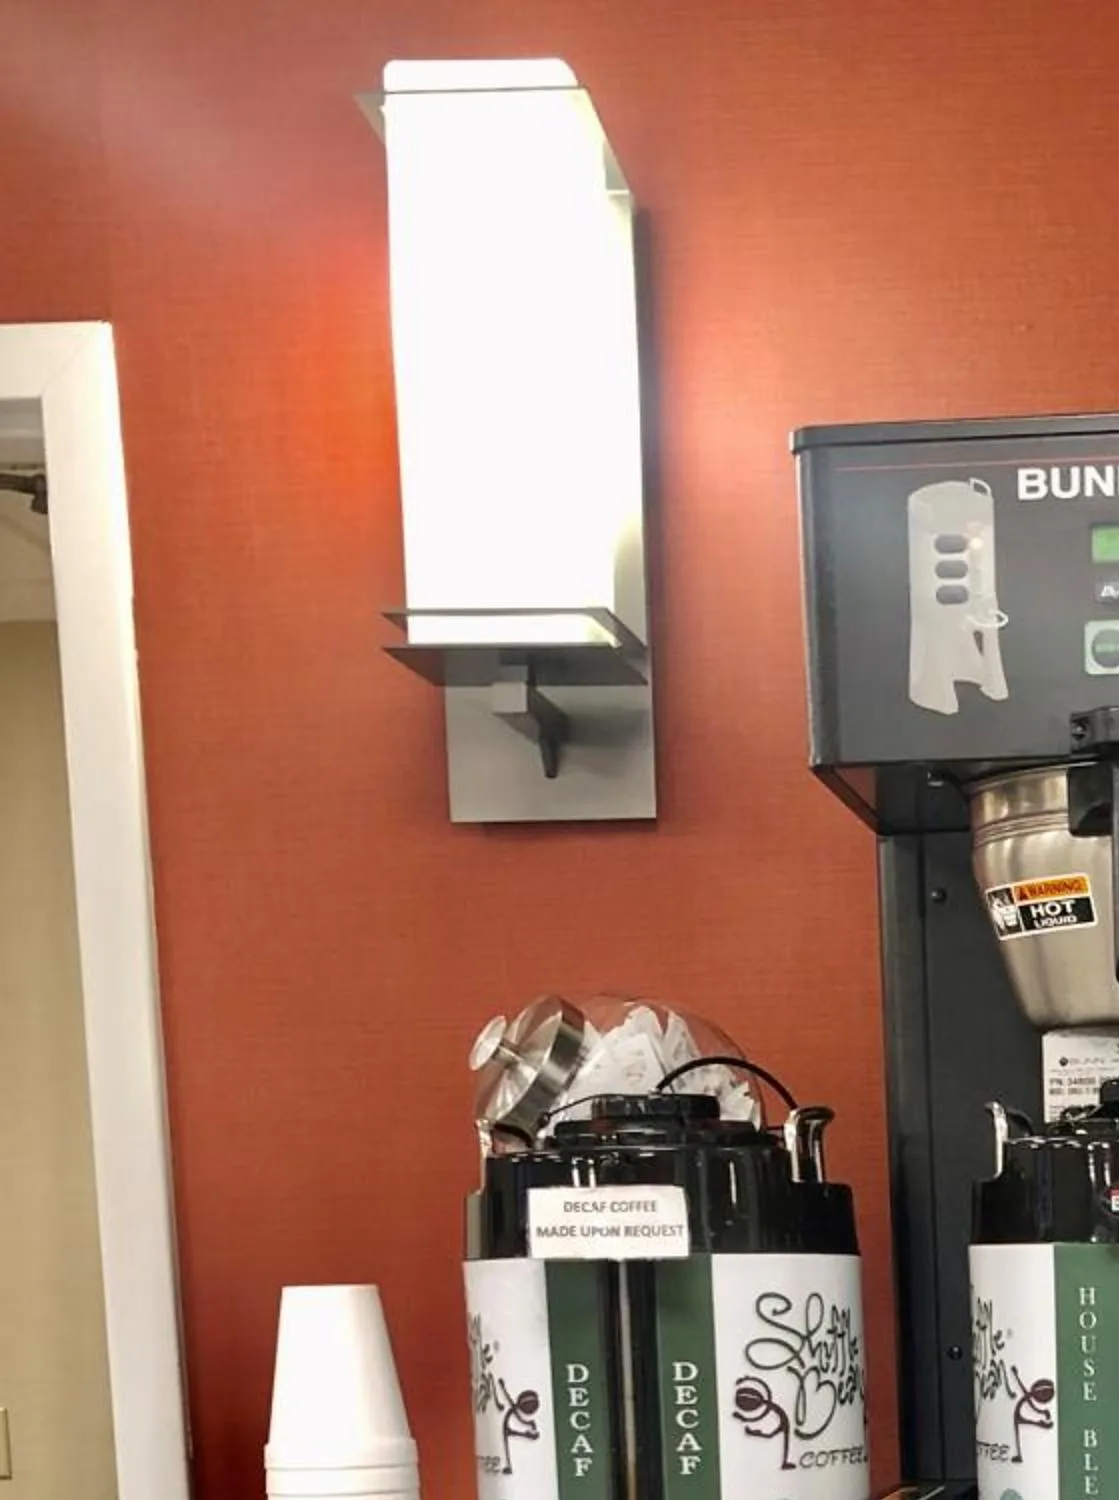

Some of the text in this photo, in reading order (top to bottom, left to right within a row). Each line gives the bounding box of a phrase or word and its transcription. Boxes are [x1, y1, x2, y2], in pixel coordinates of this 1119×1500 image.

[1030, 899, 1076, 918] HOT
[536, 1224, 684, 1239] MADE UPON REQUEST
[563, 1200, 657, 1213] DECAF COFFEE
[1079, 1286, 1098, 1402] HOUSE
[566, 1363, 594, 1477] DECAF
[671, 1361, 703, 1475] DECAF
